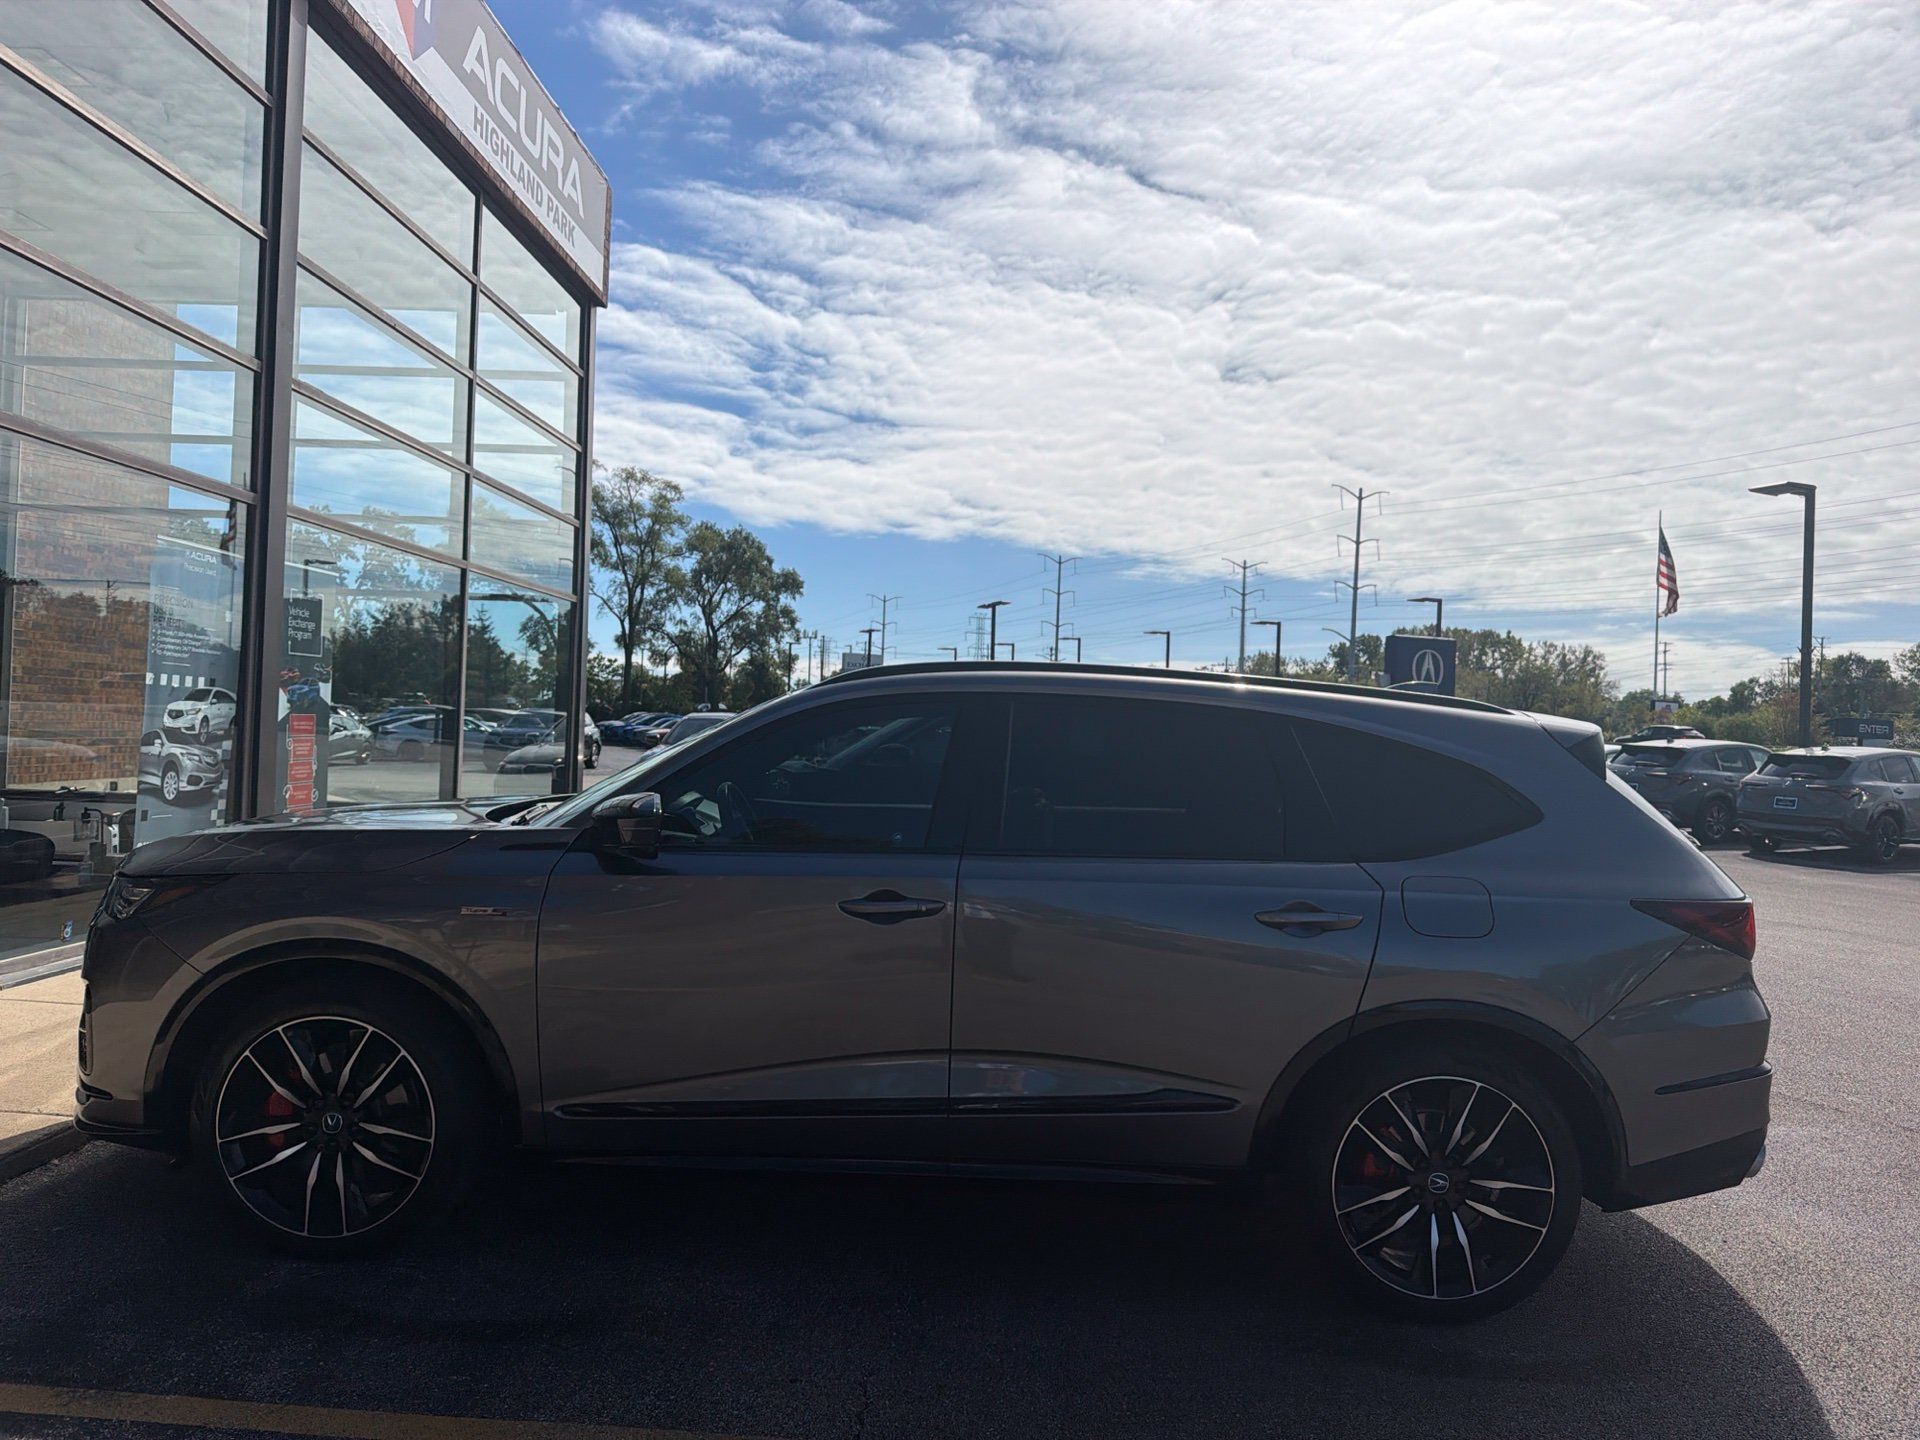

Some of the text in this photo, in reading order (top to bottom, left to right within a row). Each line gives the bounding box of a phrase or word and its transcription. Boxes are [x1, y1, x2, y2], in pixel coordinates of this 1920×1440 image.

[462, 25, 585, 218] ACURA
[473, 104, 576, 249] HIGHLAND PARK
[288, 605, 310, 618] Vehicle
[288, 616, 316, 632] Exchange
[288, 627, 312, 640] Program
[1859, 724, 1889, 734] ENTER
